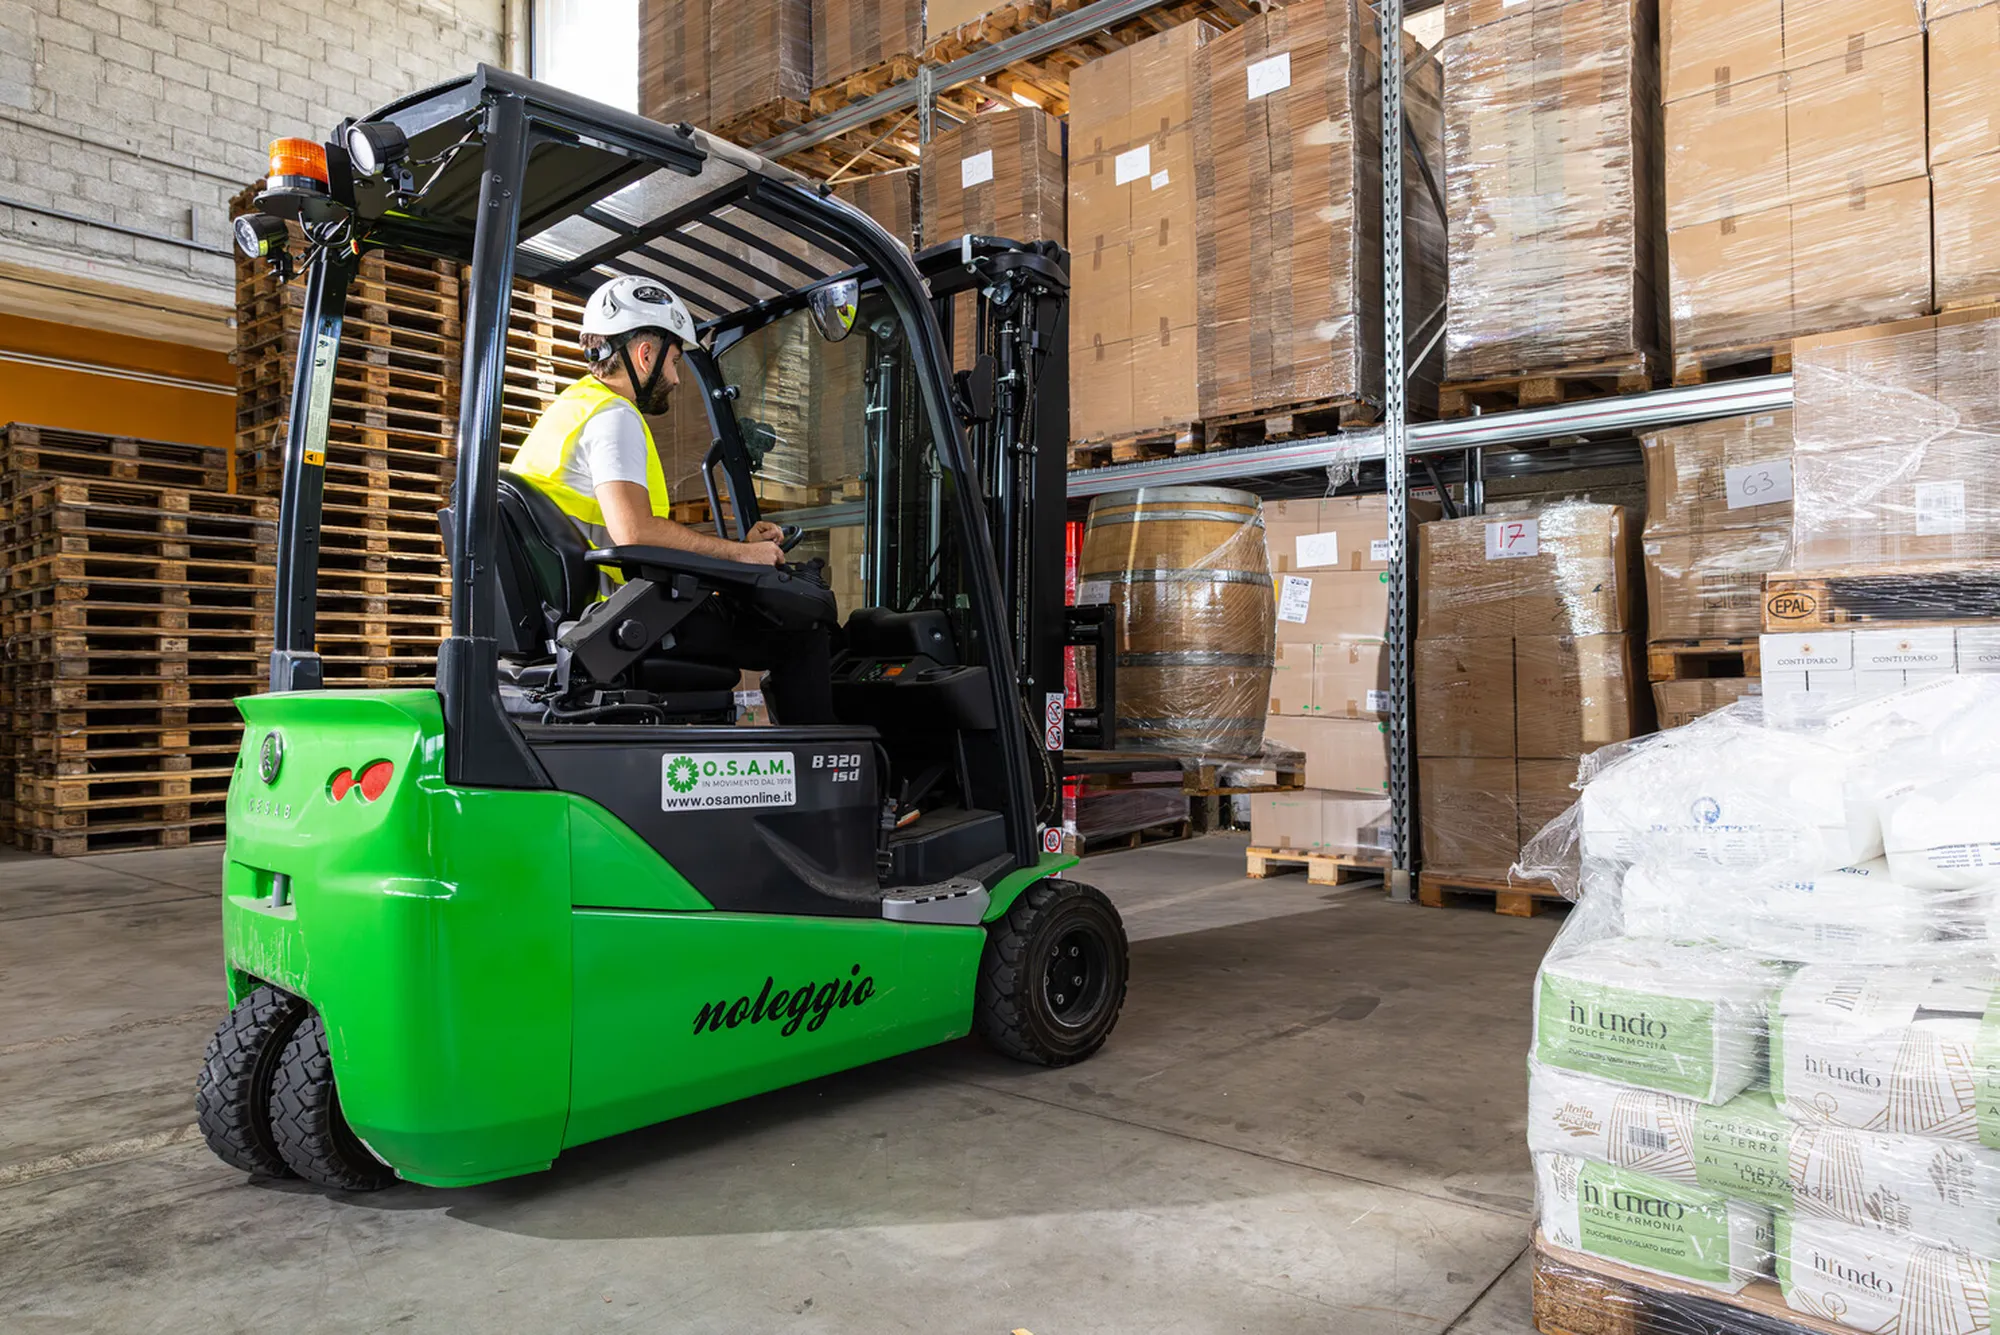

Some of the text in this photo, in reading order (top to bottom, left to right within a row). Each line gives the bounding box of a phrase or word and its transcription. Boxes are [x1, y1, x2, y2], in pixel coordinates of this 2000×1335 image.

[1742, 471, 1775, 496] 63
[1499, 523, 1525, 548] 17
[1775, 597, 1808, 615] EPAL
[1777, 657, 1838, 666] CONTI D'ARCO
[1872, 654, 1938, 663] CONTI D'ARCO
[703, 759, 791, 776] O.S.A.M.
[812, 754, 861, 768] B 320
[712, 778, 760, 788] MOVIMENTO
[761, 778, 776, 786] DAL
[777, 777, 793, 786] 1978
[832, 768, 860, 782] isd
[249, 797, 292, 819] CESAB
[666, 790, 793, 808] www.osamonline.it
[692, 963, 876, 1037] noleggio
[1569, 1025, 1667, 1051] DOLCE ARMONIA
[1805, 1054, 1881, 1089] infundo
[1552, 1108, 1603, 1132] Zuccheri
[1564, 1101, 1594, 1118] Italia
[1703, 1133, 1778, 1154] LA TERRA
[1583, 1179, 1684, 1221] infundo
[1584, 1206, 1685, 1233] DOLCE ARMONIA
[1585, 1228, 1623, 1244] ZUCCHERO
[1623, 1236, 1659, 1251] VAGLIATO
[1660, 1245, 1686, 1258] MEDIO
[1813, 1251, 1893, 1294] infundo
